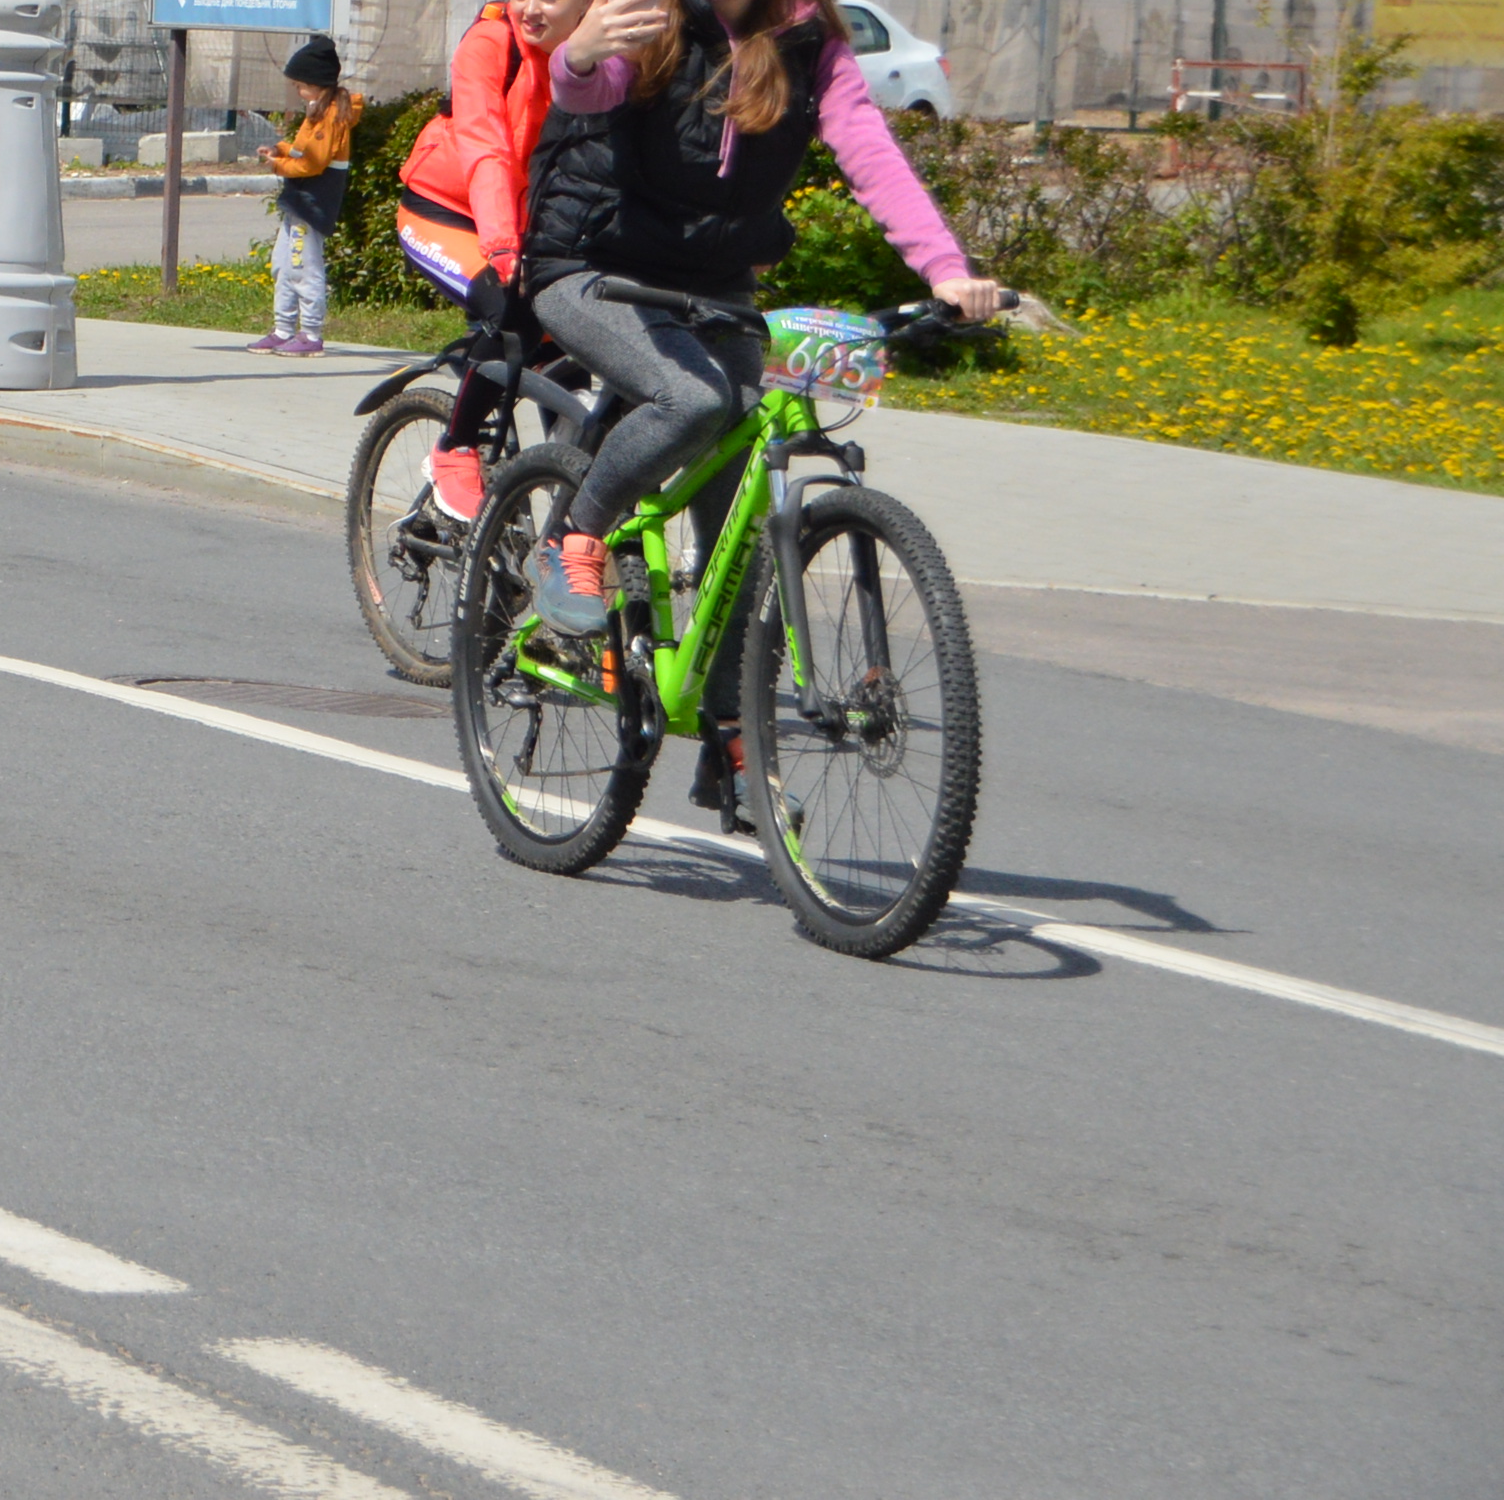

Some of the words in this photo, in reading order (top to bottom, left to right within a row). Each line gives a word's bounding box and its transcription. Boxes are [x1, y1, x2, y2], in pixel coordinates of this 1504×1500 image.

[400, 224, 462, 276] ВелоТверь
[786, 336, 872, 389] 605
[693, 515, 760, 676] FORMAT
